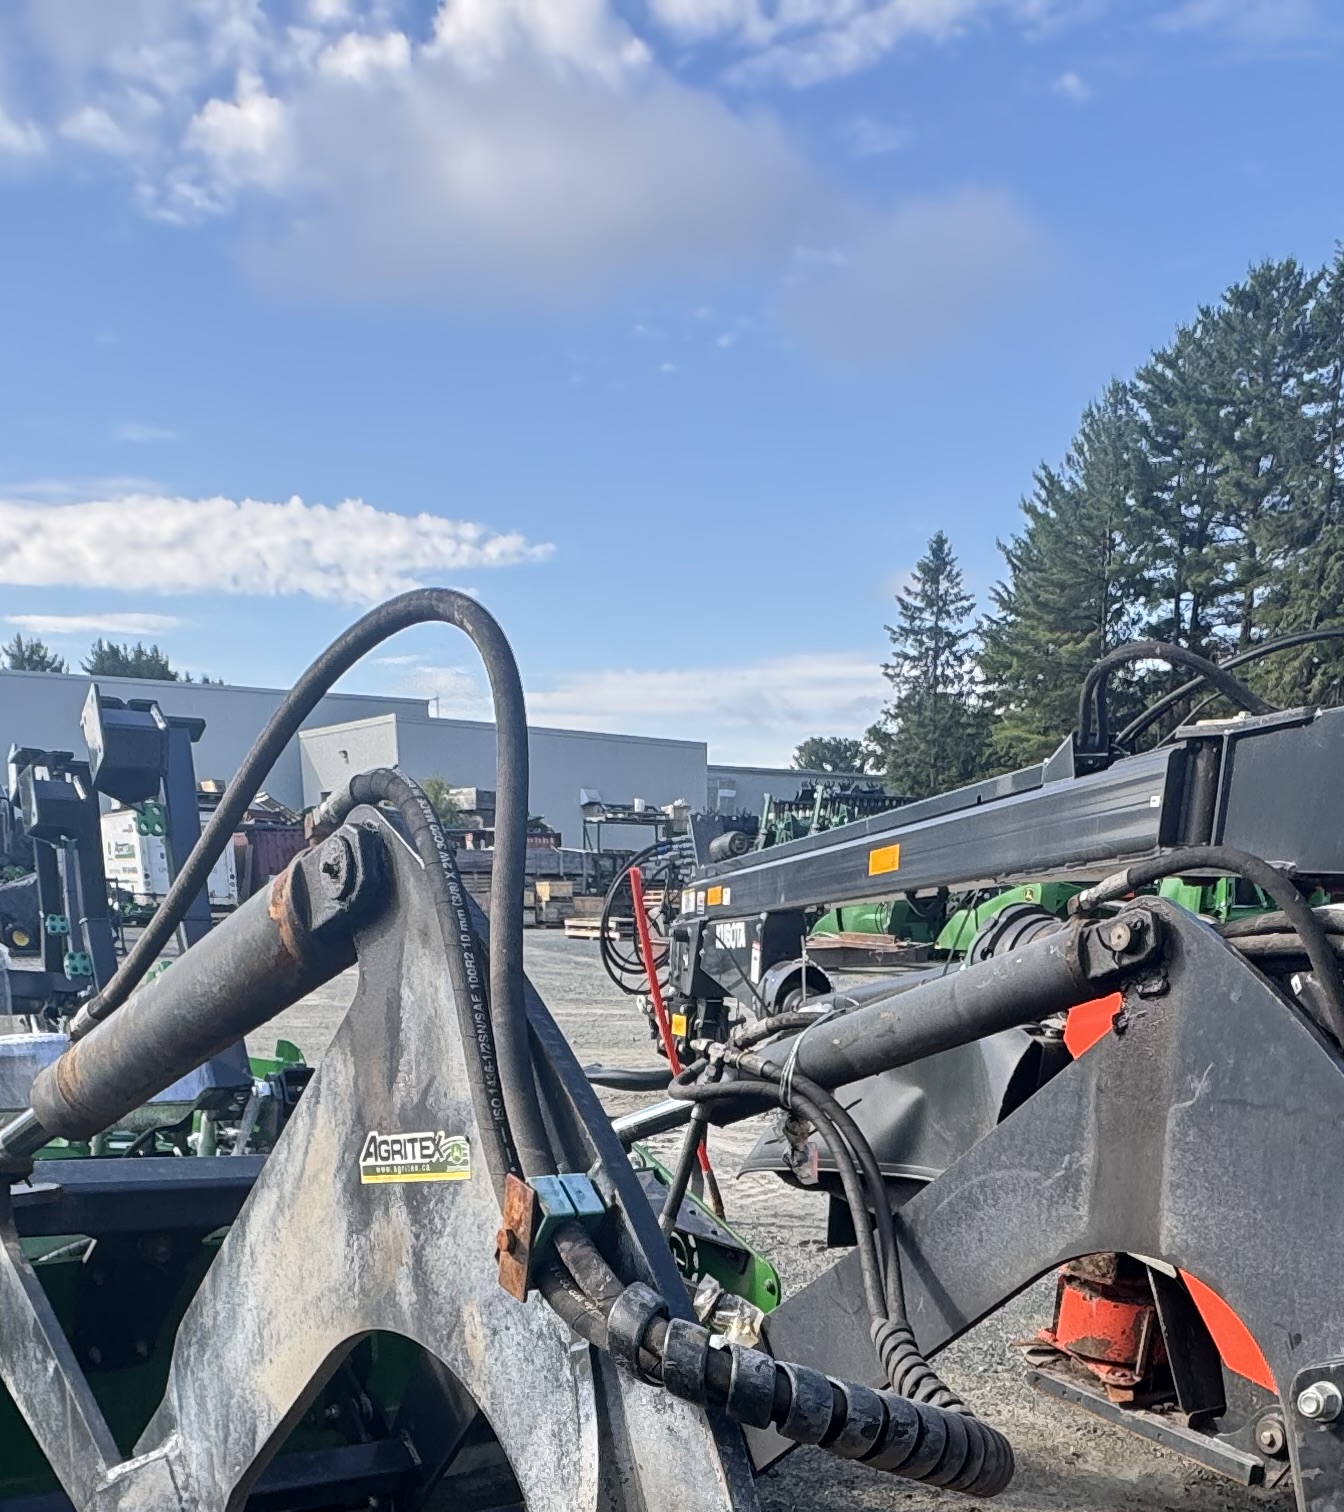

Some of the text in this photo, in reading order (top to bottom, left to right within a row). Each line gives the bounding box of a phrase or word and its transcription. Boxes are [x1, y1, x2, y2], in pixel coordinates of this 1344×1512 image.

[447, 881, 464, 907] (3/8)
[456, 908, 469, 932] mm
[460, 934, 472, 949] 10
[463, 951, 479, 990] 100R2
[490, 1097, 505, 1122] ISO
[362, 1134, 445, 1163] AGRITEX
